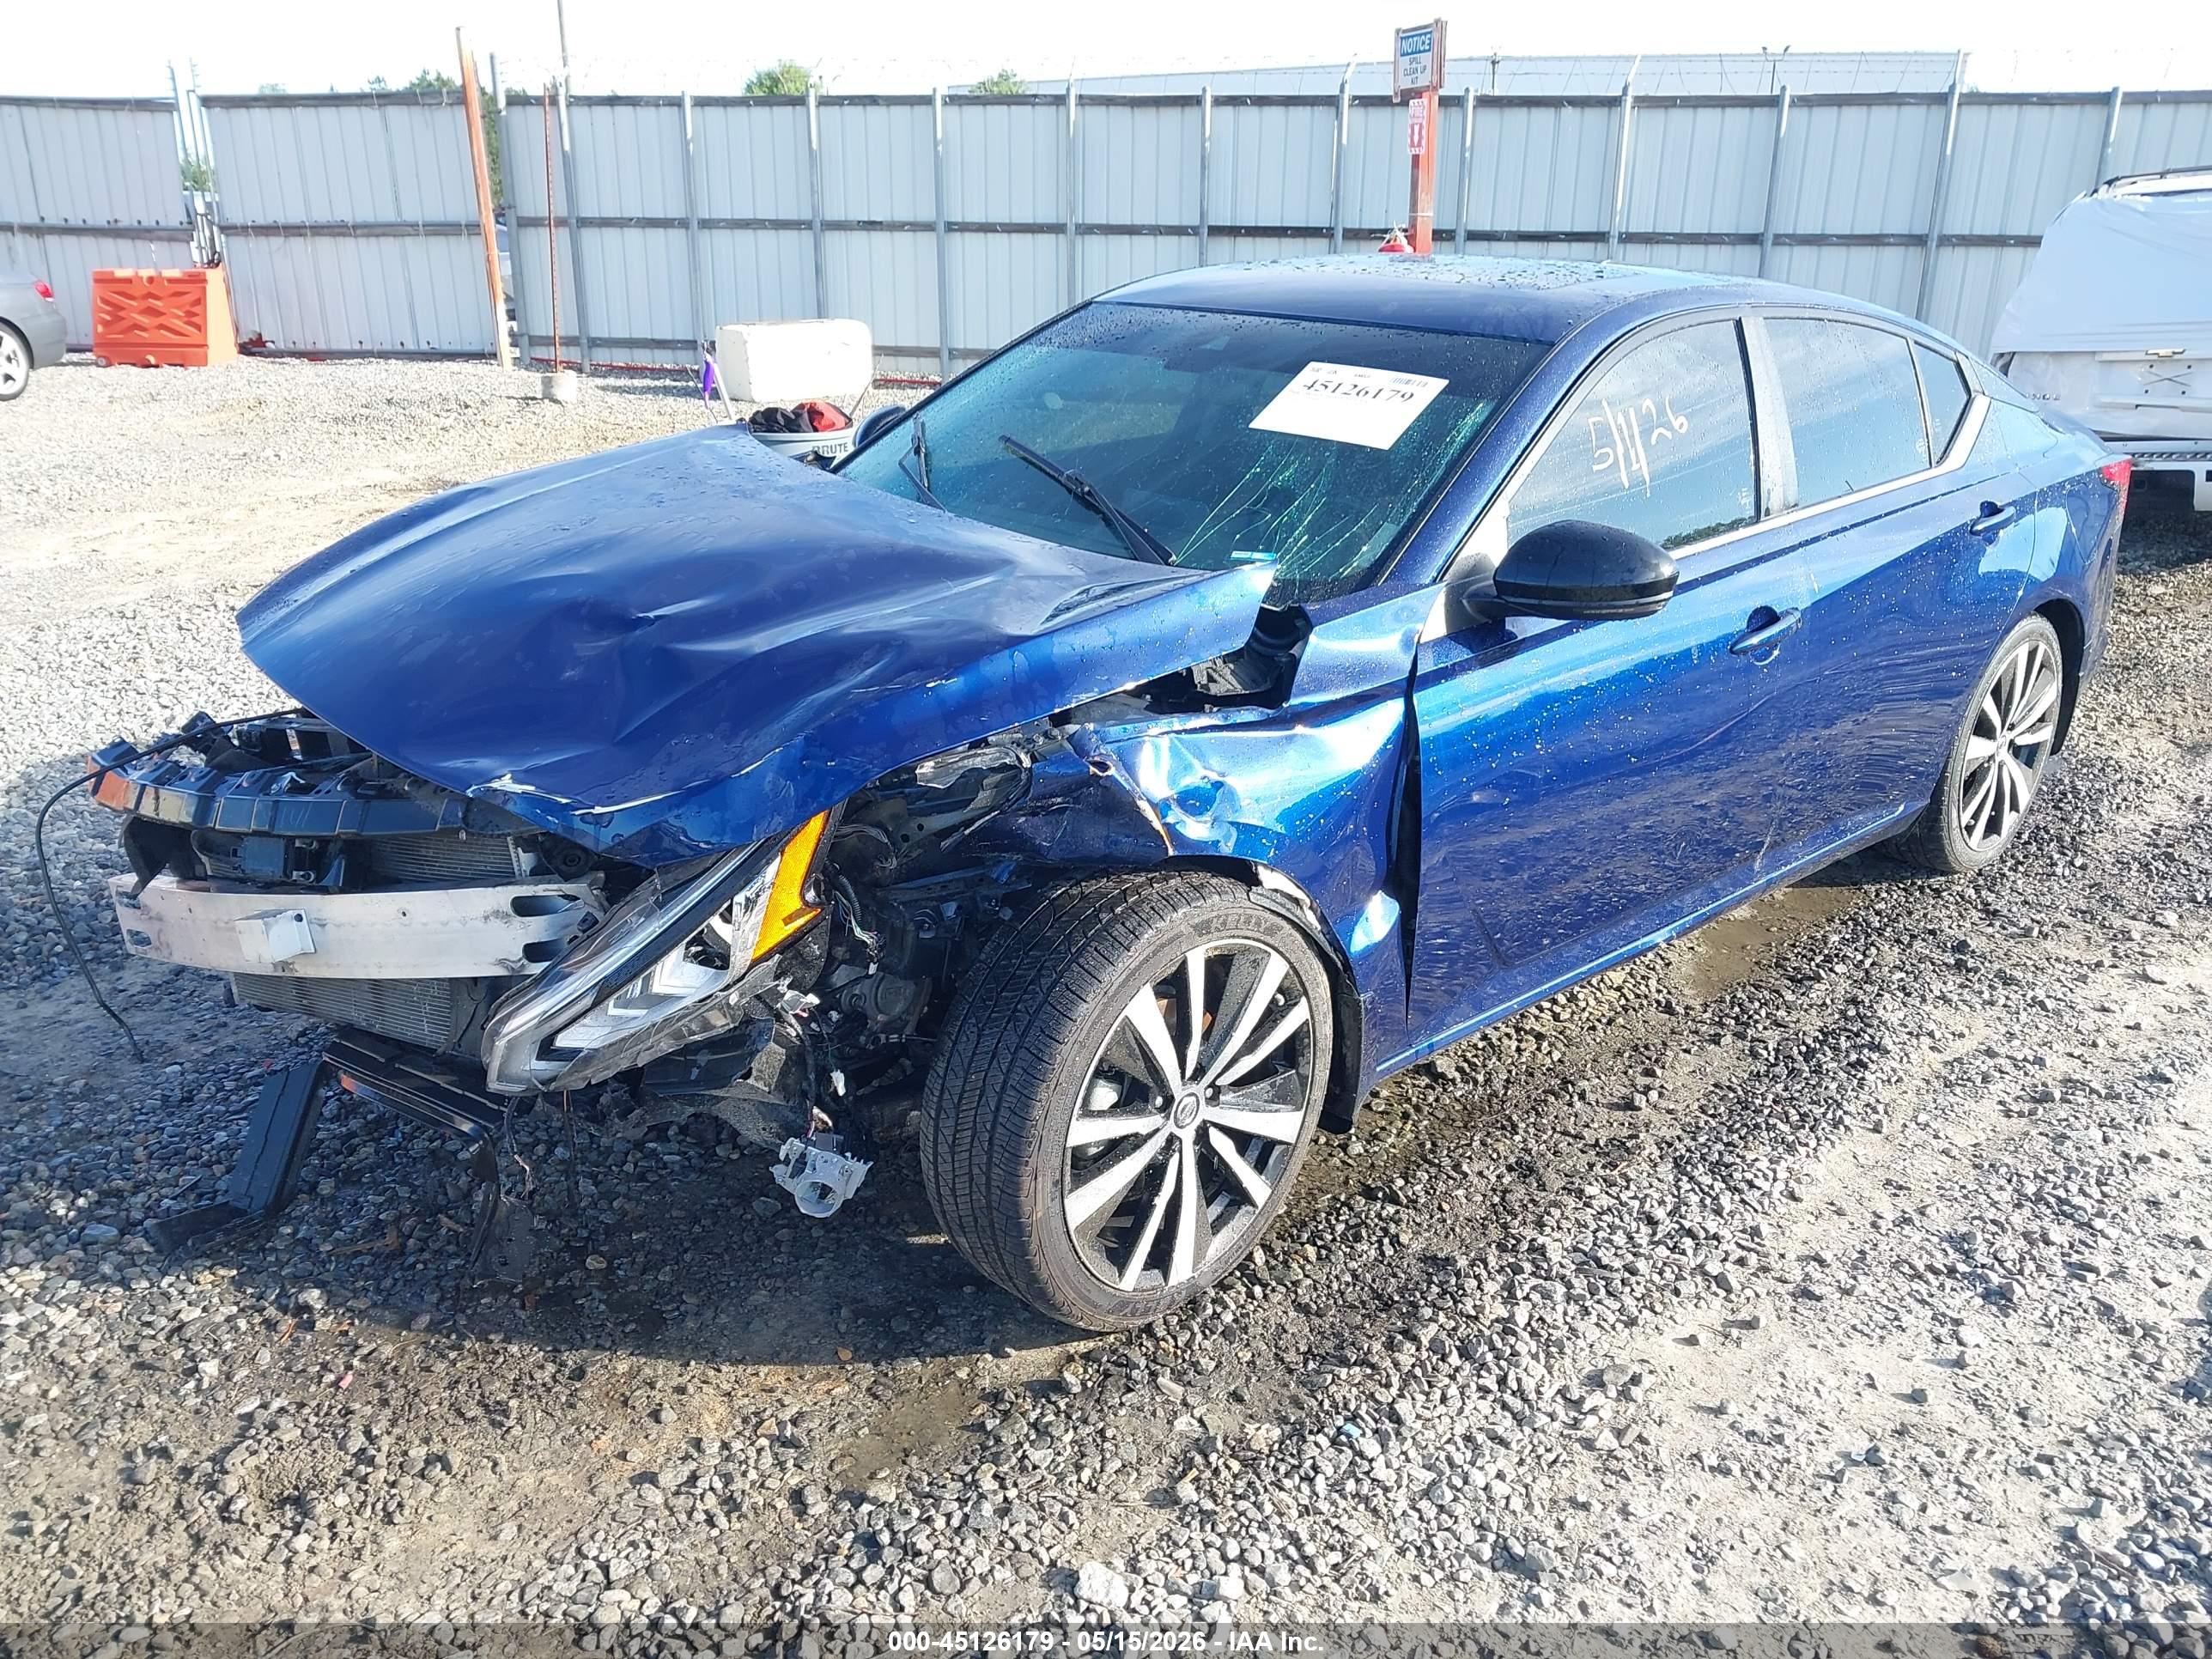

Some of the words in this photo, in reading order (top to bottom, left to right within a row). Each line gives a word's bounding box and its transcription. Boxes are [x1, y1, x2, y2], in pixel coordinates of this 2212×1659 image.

[1401, 33, 1431, 54] NOTICE
[1409, 55, 1422, 66] SPILL
[1403, 66, 1419, 77] CLEAN
[1419, 64, 1427, 74] UP
[1303, 379, 1415, 404] 45126179
